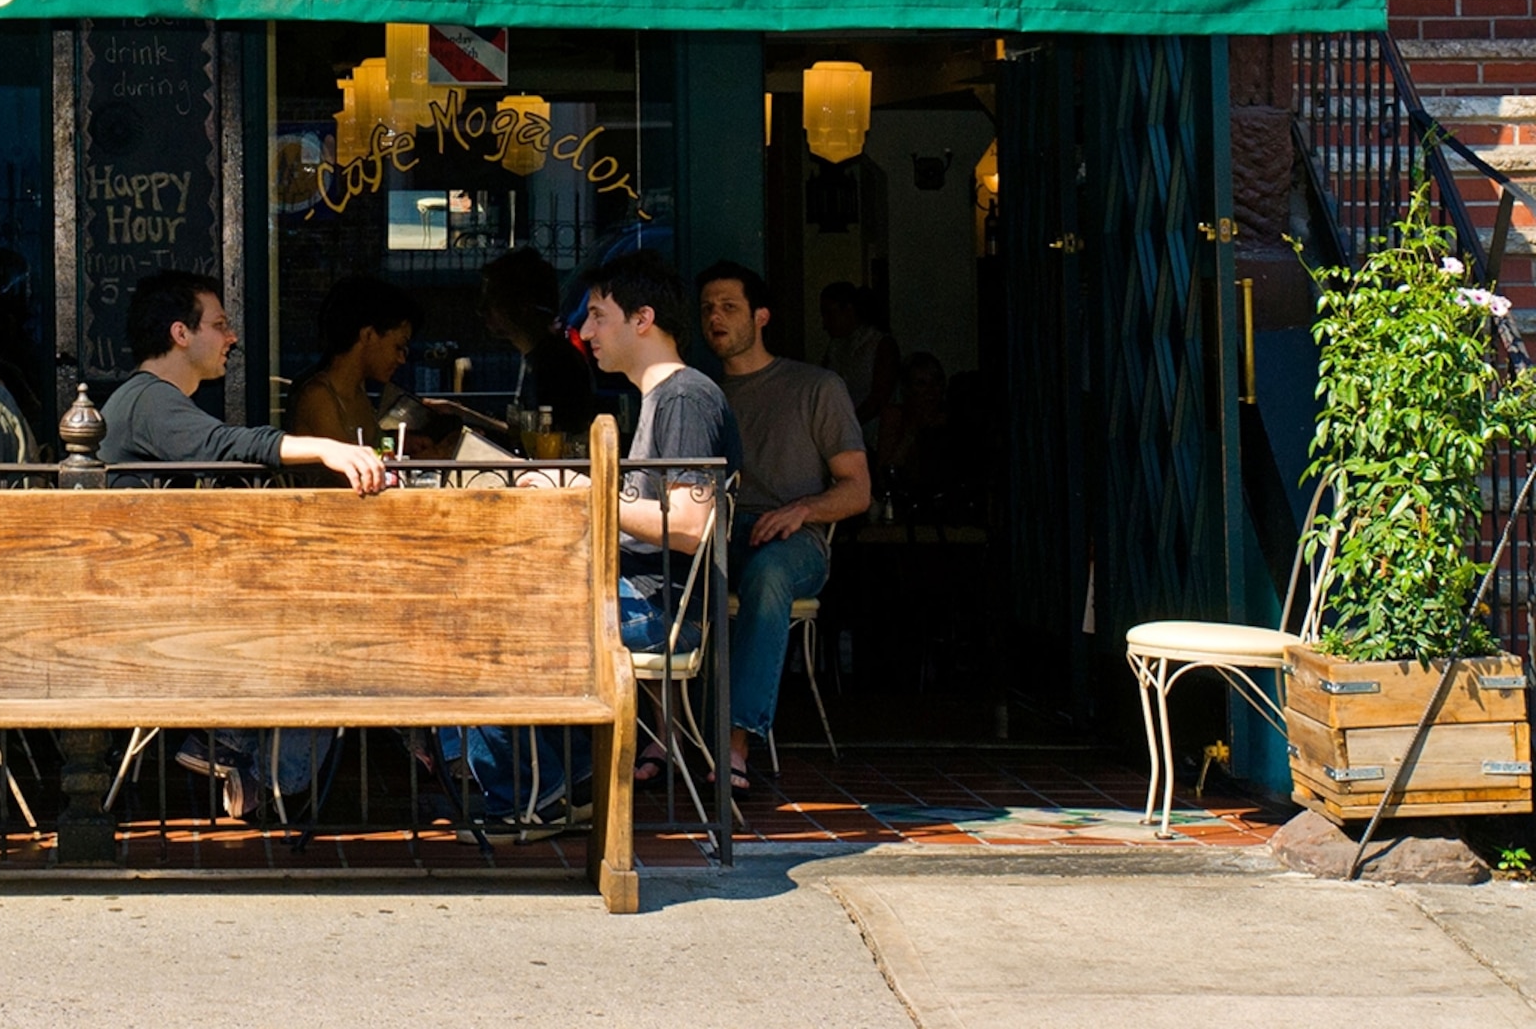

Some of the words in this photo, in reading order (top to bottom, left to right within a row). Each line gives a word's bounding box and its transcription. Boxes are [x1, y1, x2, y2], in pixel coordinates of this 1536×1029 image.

[105, 36, 175, 64] drink
[113, 76, 191, 115] during
[317, 124, 420, 213] Cafe
[428, 89, 639, 201] Mogador
[86, 164, 192, 213] Happy
[105, 206, 186, 244] Hour
